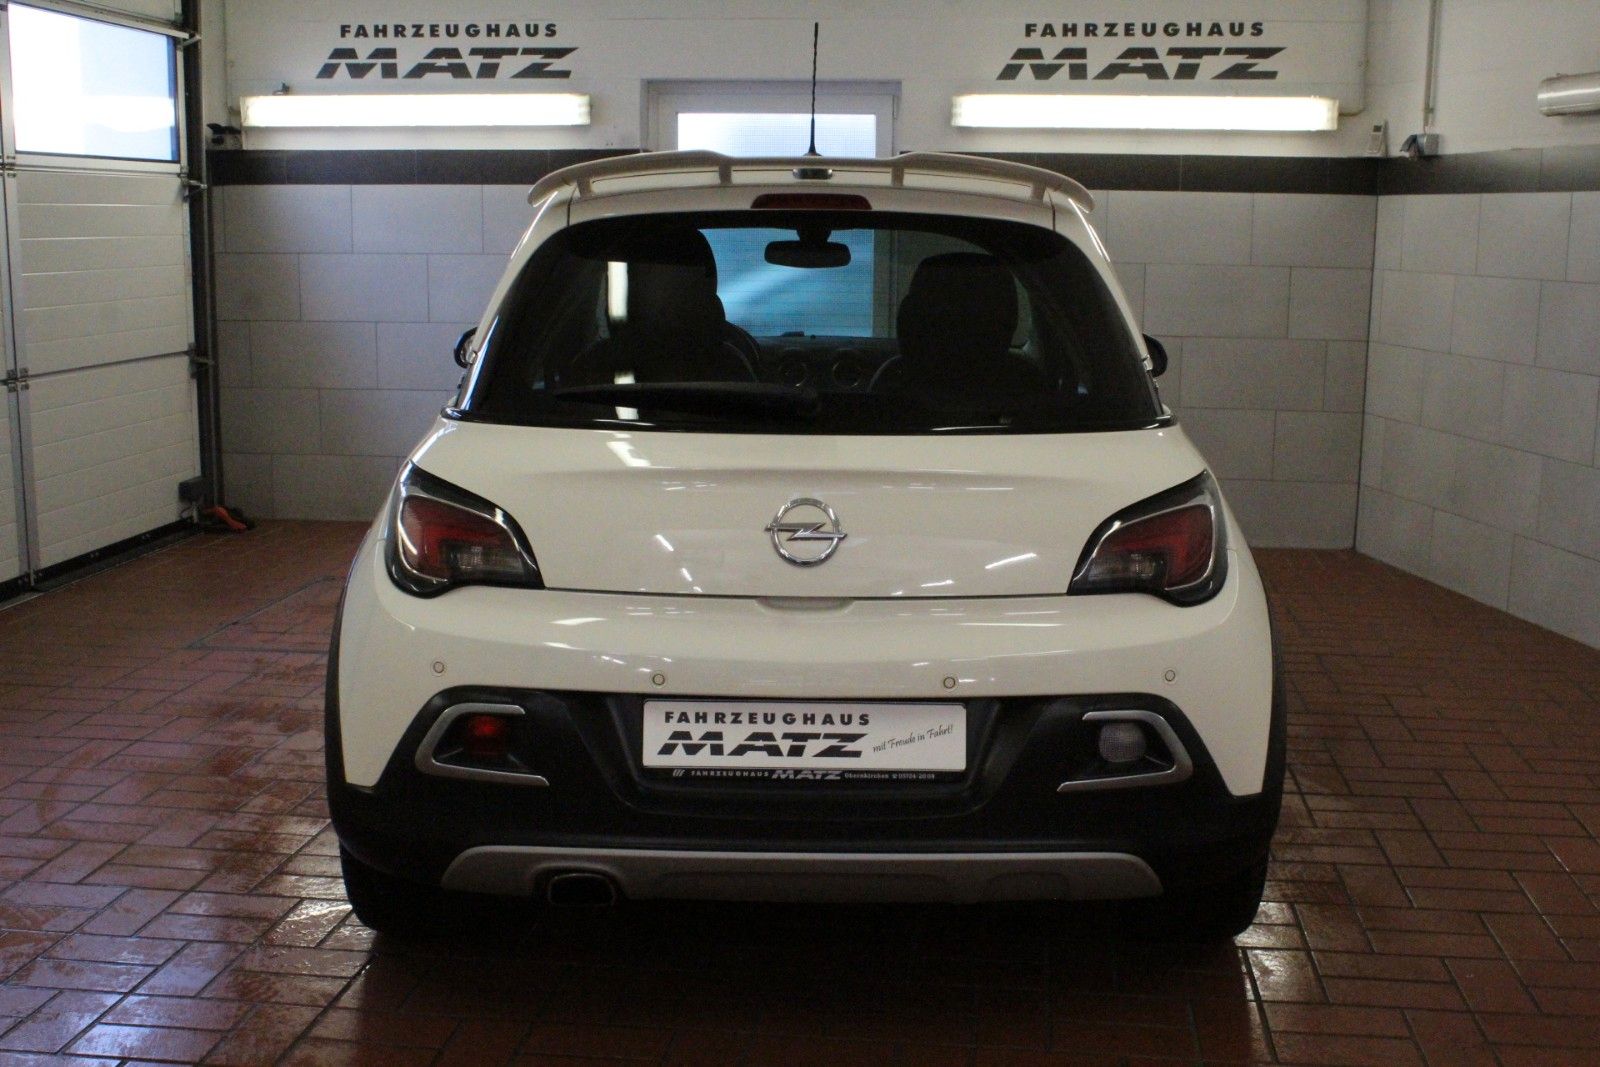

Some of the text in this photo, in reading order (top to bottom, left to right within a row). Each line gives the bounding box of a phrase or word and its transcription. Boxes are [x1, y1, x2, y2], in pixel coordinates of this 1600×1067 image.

[339, 23, 558, 39] FAHRZEUGHAUS
[1024, 21, 1265, 38] FAHRZEUGHAUS
[315, 47, 580, 80] MATZ
[995, 46, 1288, 81] MATZ
[664, 711, 870, 726] FAHRZEUGHAUS
[656, 730, 869, 758] MATZ
[872, 724, 954, 753] mit Freude in Fahrt!
[691, 769, 769, 778] FAHRZEUGHAUS
[771, 768, 842, 780] MATZ
